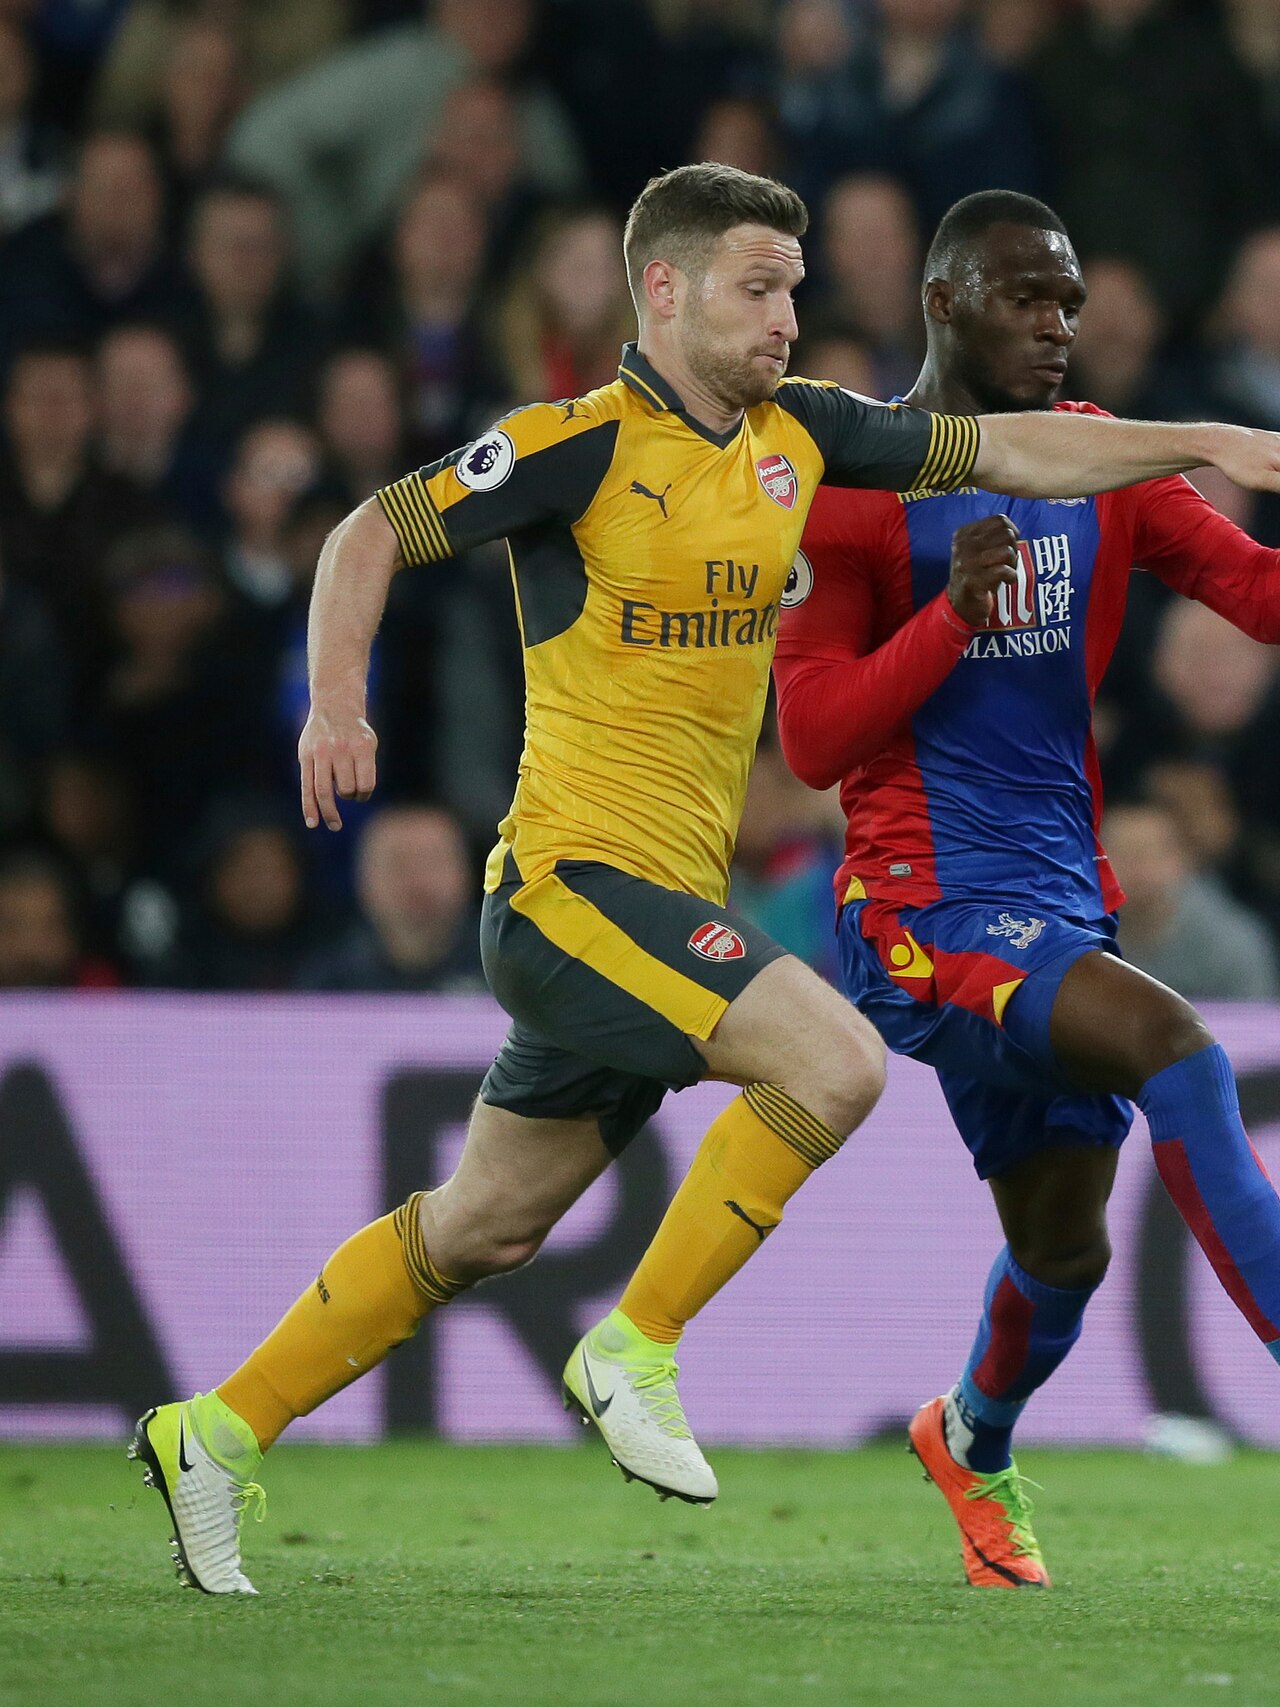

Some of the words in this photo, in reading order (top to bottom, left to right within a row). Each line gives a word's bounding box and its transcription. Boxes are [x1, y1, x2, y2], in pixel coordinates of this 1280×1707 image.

[760, 461, 787, 476] Arsenal
[705, 559, 759, 598] Fly
[959, 626, 1071, 659] MANSION
